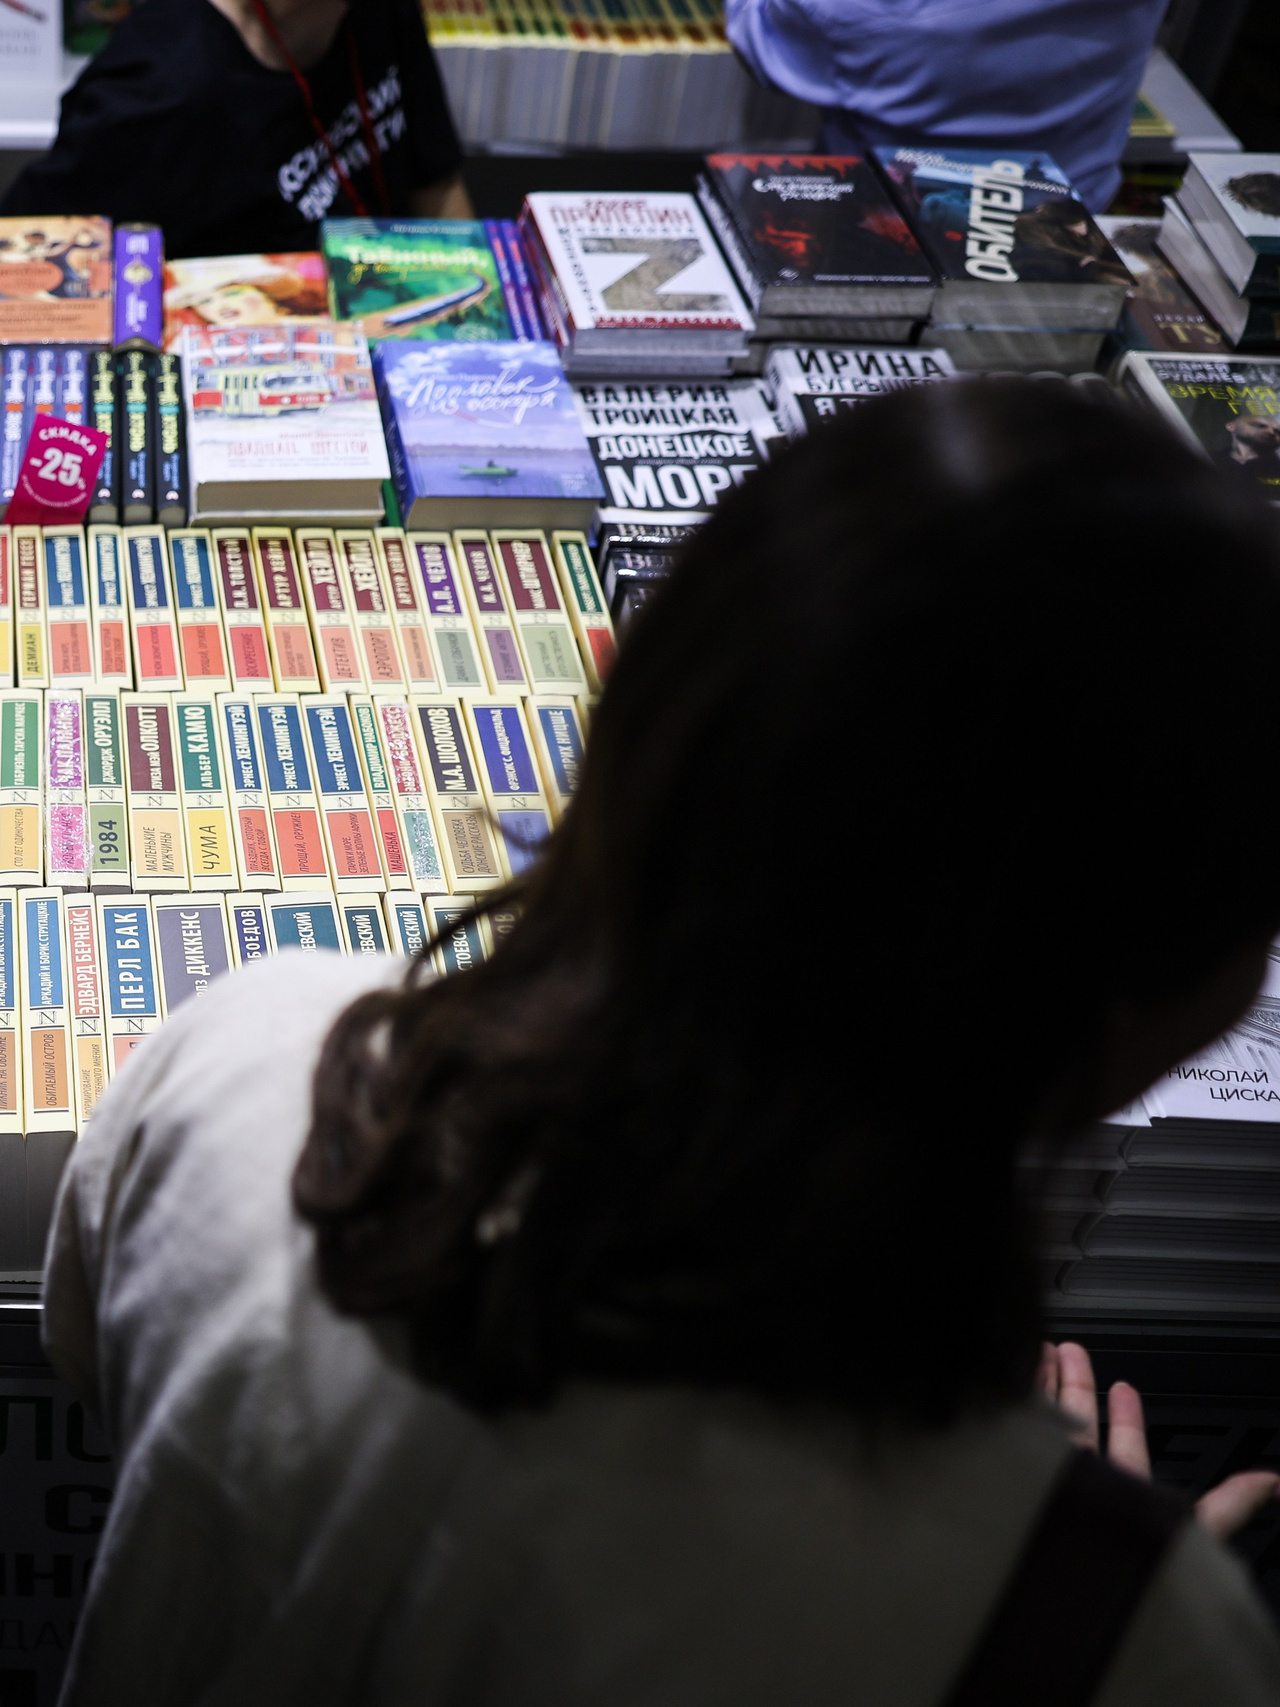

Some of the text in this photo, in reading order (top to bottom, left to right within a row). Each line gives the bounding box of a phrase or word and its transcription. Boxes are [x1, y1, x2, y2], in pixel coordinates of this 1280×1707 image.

[550, 206, 693, 225] ПРИЛЕПИН
[965, 160, 1024, 282] ОБИТЕЛЬ
[795, 350, 947, 377] ИРИНА
[581, 385, 731, 407] ВАЛЕРИЯ
[589, 407, 738, 427] ТРОИЦКАЯ
[39, 427, 97, 456] СКИДКА
[599, 435, 754, 460] ДОНЕЦКОЕ
[422, 544, 447, 583] ЧЕХОВ
[93, 701, 116, 783] ДЖОРДЖ ОРУЭЛЛ
[138, 707, 160, 752] ОЛКОТТ
[184, 706, 213, 788] АЛЬБЕР КАМЮ
[227, 705, 255, 788] ЭРНЕСТ ХЕМИНГУЭЙ
[268, 706, 298, 789] ЭРНЕСТ ХЕМИНГУЭЙ
[316, 707, 350, 791] ЭРНЕСТ ХЕМИНГУЭЙ
[358, 707, 386, 788] ВЛАДИМИР НАБОКОВ
[427, 708, 467, 790] М.А. ШОЛОХОВ
[548, 710, 570, 744] НИЦШЕ
[14, 751, 25, 785] ГАБРИЭЛЬ
[15, 808, 24, 846] ОДИНОЧЕСТВА
[98, 820, 119, 865] 1984
[143, 826, 158, 872] МАЛЕНЬКИЕ
[199, 825, 220, 870] ЧУМА
[291, 812, 309, 873] ПРОЩАЙ, ОРУЖИЕ!
[451, 818, 475, 874] СУДЬБА ЧЕЛОВЕКА
[466, 814, 491, 873] ДОНСКИЕ РАССКАЗЫ
[160, 831, 174, 872] МУЖЧИНЫ
[385, 832, 403, 871] МАШЕНЬКА
[37, 902, 53, 1005] АРКАДИЙ БОРИС СТРУГАЦКИЕ
[70, 909, 99, 1014] ЭДВАРД БЕРНЕЙС
[114, 912, 145, 1009] ПЕРЛ БАК
[180, 911, 210, 976] ДИККЕНС
[43, 1033, 57, 1106] ОБИТАЕМЫЙ ОСТРОВ
[1168, 1066, 1269, 1084] НИКОЛАЙ
